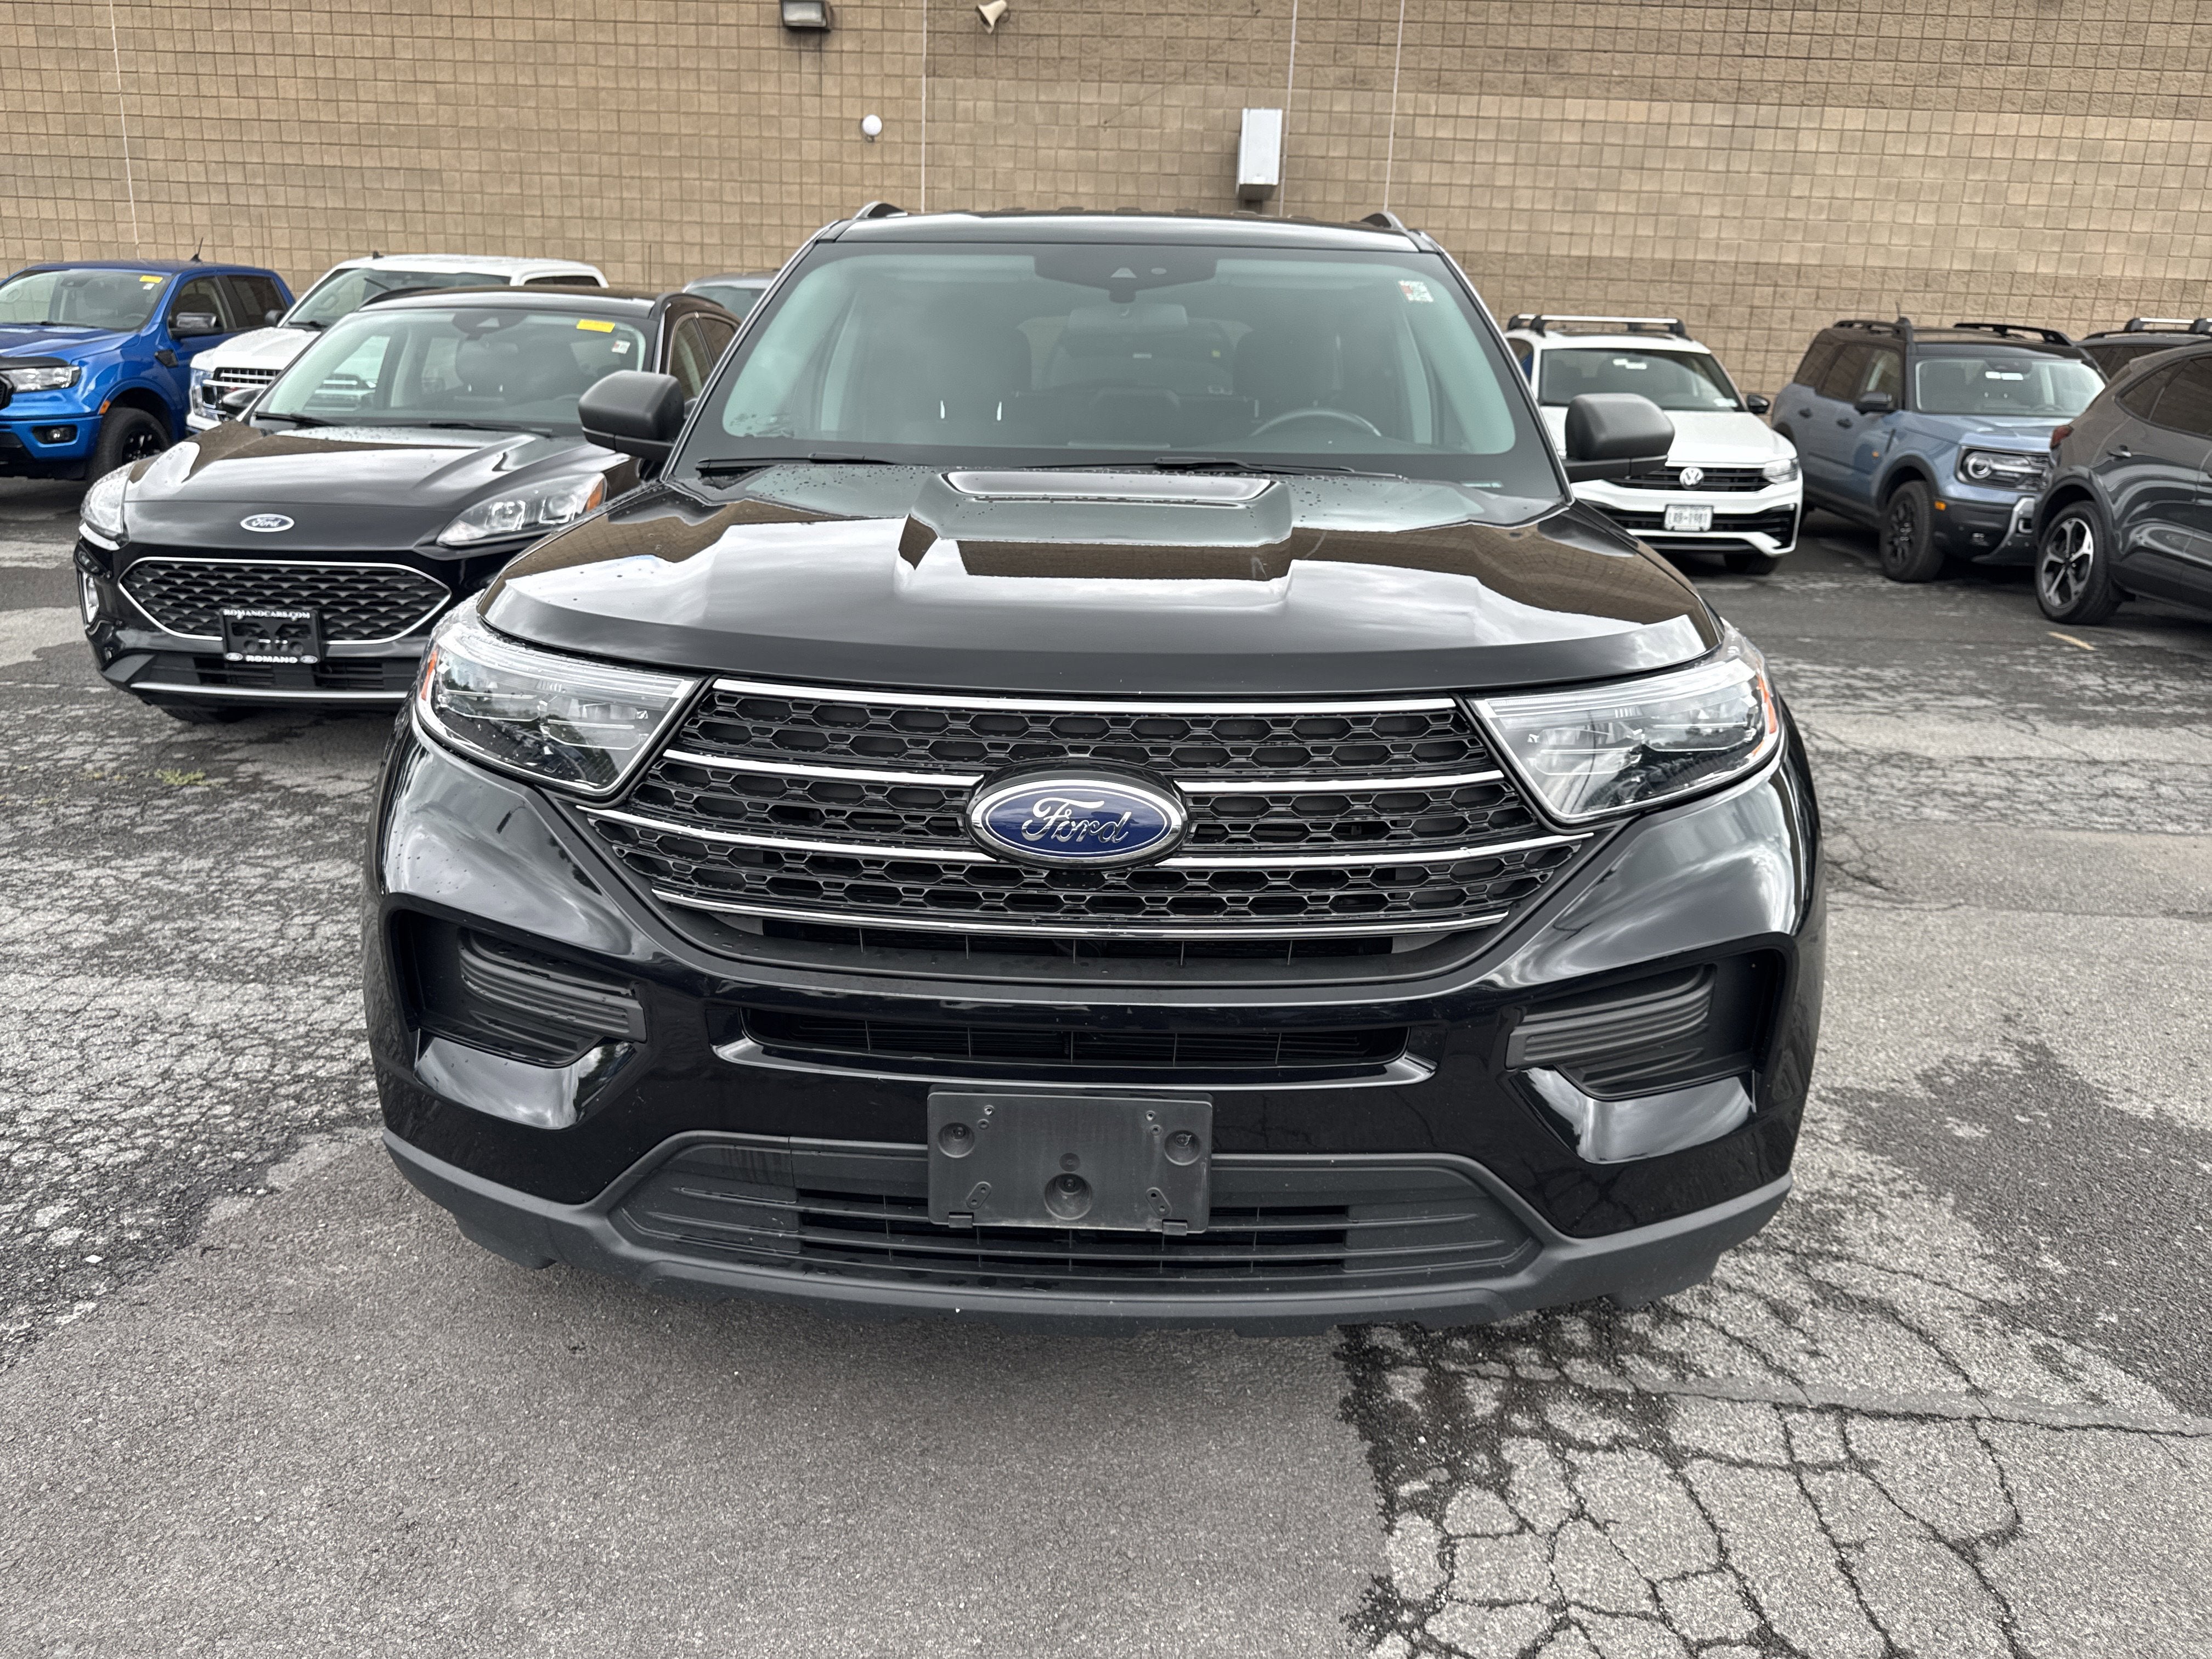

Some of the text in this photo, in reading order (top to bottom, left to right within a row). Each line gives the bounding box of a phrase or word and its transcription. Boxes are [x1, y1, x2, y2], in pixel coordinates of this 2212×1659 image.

[223, 609, 311, 619] ROMANOCARS.COM
[245, 654, 298, 664] ROMANO
[1021, 797, 1132, 844] Ford
